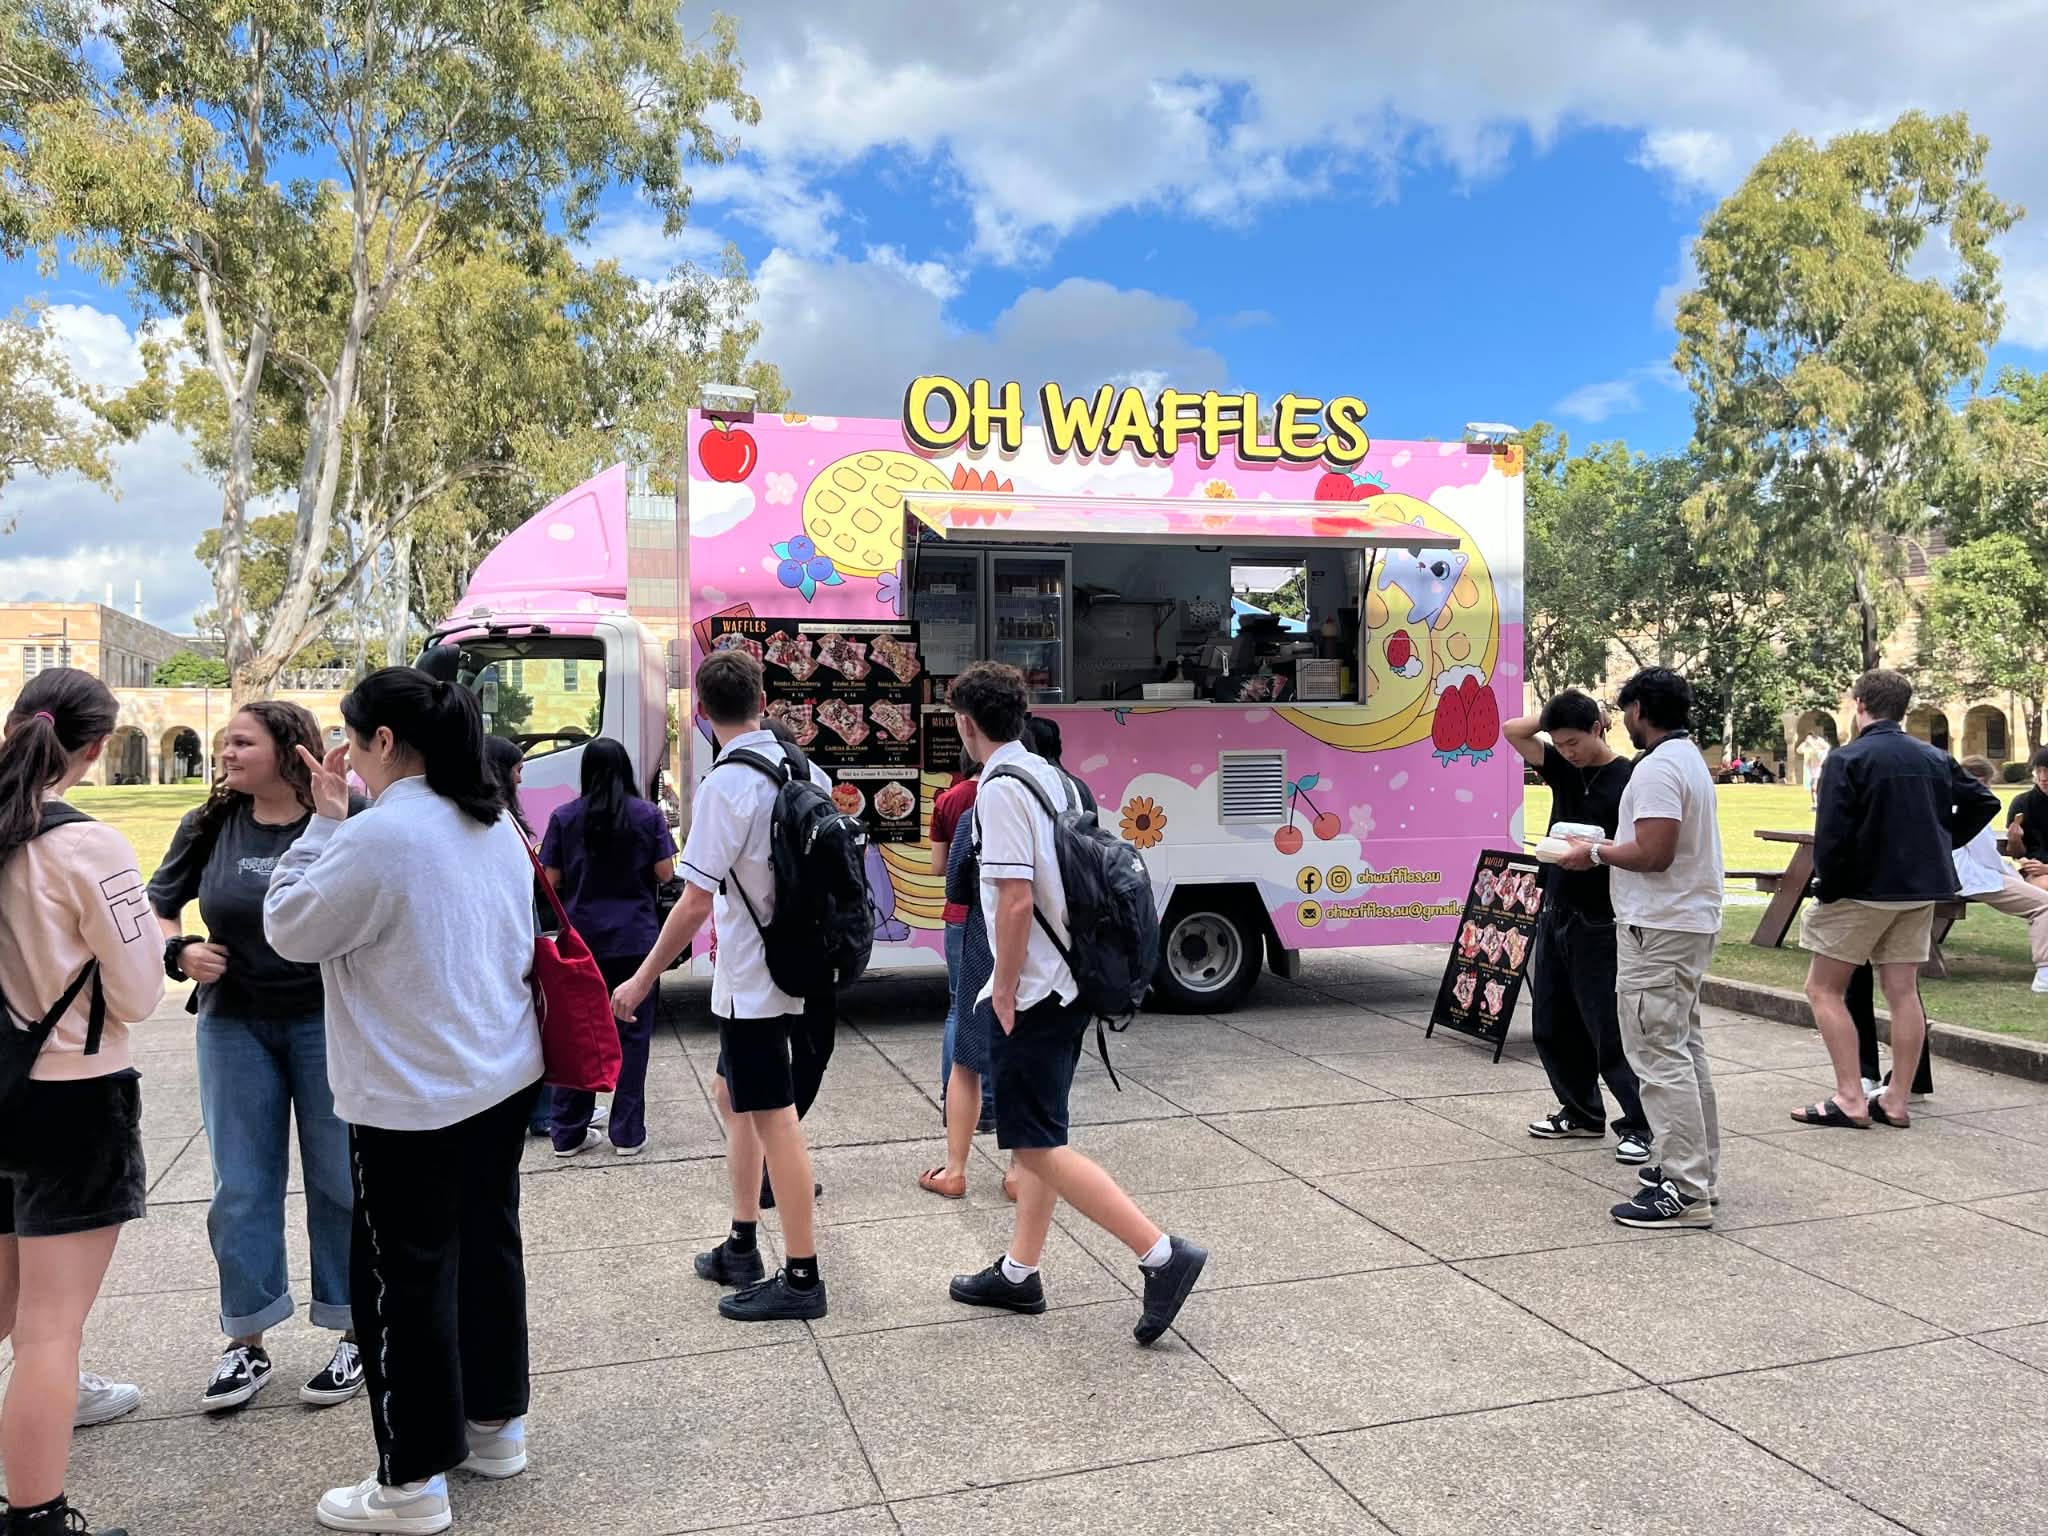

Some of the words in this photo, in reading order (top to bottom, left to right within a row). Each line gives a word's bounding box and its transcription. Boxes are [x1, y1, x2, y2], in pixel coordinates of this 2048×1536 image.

[904, 375, 1023, 450] OH
[1040, 384, 1368, 467] WAFFLES
[722, 620, 768, 633] WAFFLES
[1357, 868, 1440, 884] ohwaffles.au
